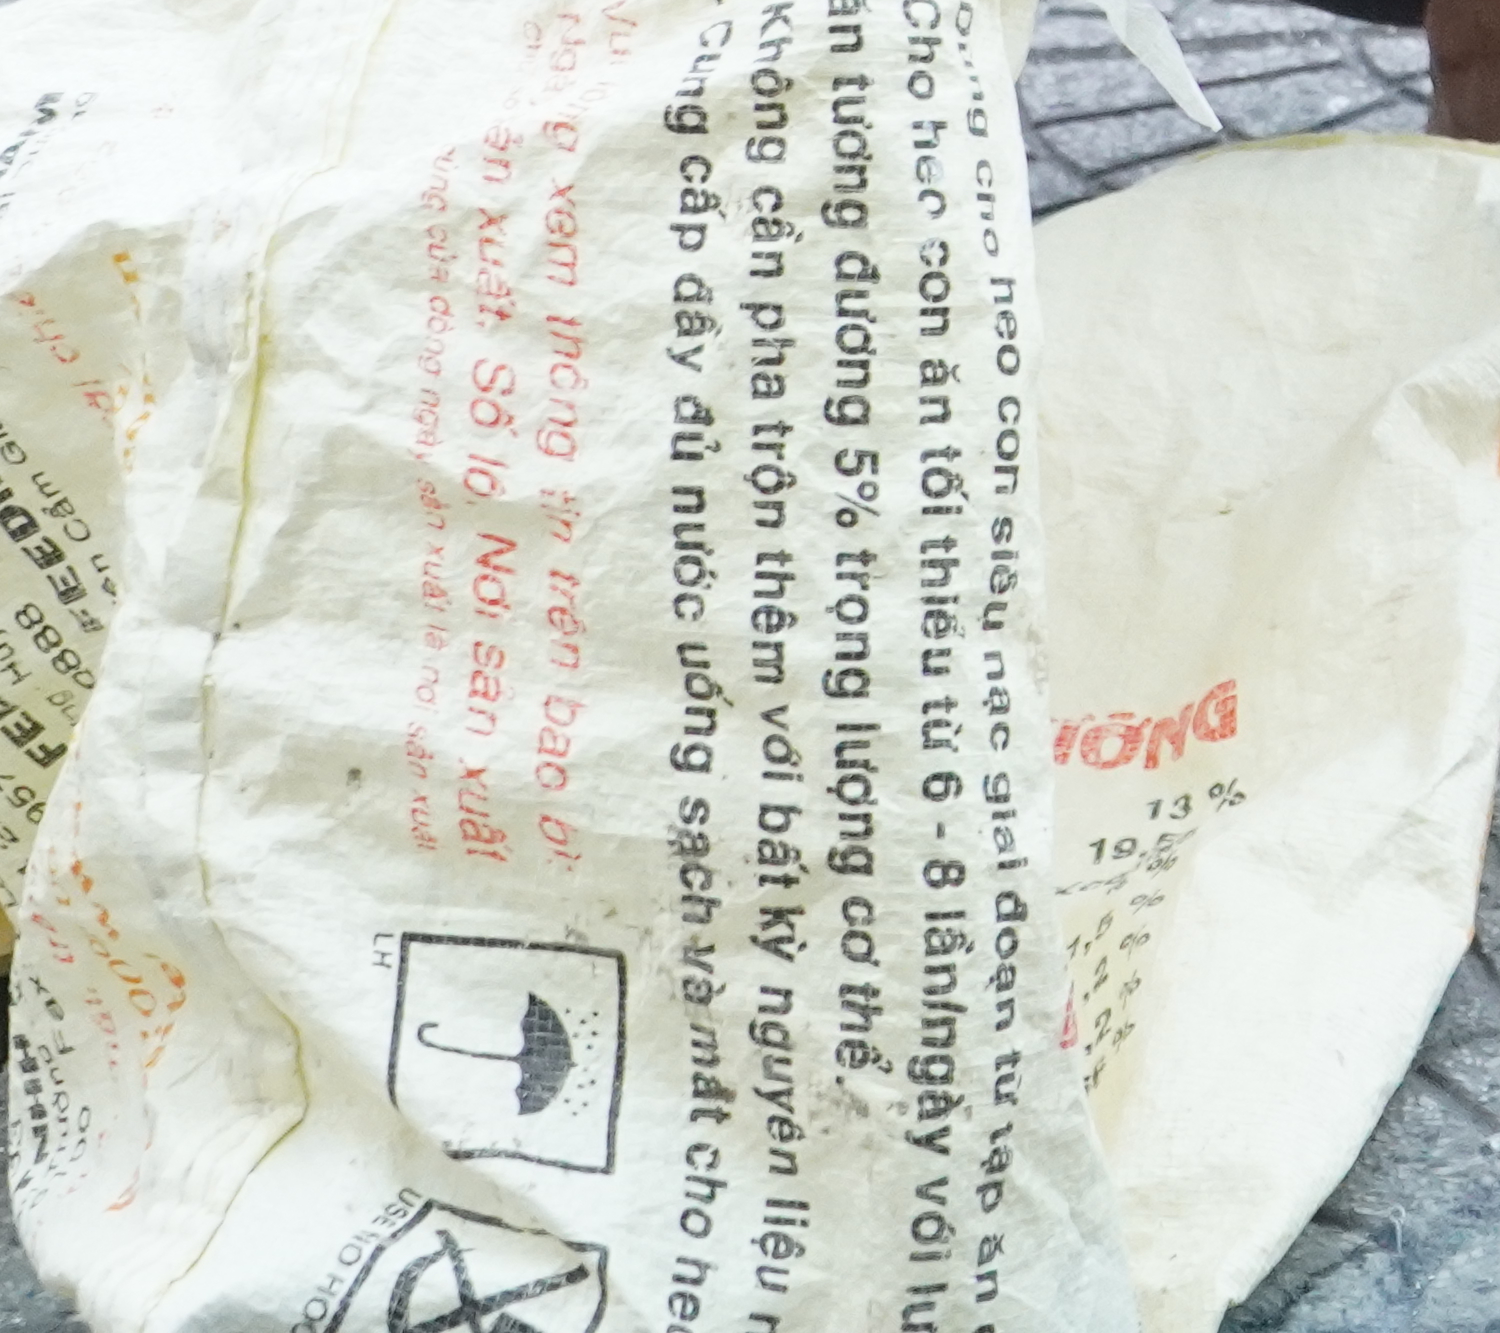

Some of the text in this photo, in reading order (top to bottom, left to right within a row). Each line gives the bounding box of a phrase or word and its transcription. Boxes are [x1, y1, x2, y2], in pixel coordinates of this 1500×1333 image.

[664, 19, 734, 136] Cung
[747, 2, 795, 162] Không
[821, 74, 878, 230] tương
[543, 182, 580, 287] xem
[675, 156, 727, 252] cấp
[750, 186, 802, 279] cần
[975, 160, 1001, 258] cho
[666, 274, 722, 372] đầy
[918, 239, 950, 337] con
[991, 275, 1022, 376] heo
[741, 302, 794, 401] pha
[824, 252, 880, 427] đương
[470, 358, 518, 439] Số
[670, 395, 722, 462] đủ
[919, 360, 961, 425] ăn
[742, 422, 794, 529] trộn
[831, 449, 880, 529] 5%
[919, 445, 970, 517] tối
[994, 395, 1023, 495] con
[538, 488, 580, 546] tin
[670, 486, 717, 622] nước
[472, 532, 518, 621] Nơi
[545, 569, 587, 670] trên
[751, 551, 797, 685] thêm
[822, 552, 878, 699] trọng
[534, 696, 587, 791] bao
[669, 642, 738, 774] uống
[759, 705, 803, 782] với
[920, 697, 968, 754] từ
[983, 651, 1014, 753] nạc
[458, 764, 512, 864] xuất
[826, 722, 881, 875] lượng
[921, 772, 964, 803] 6
[980, 772, 1028, 872] giai
[1148, 793, 1193, 820] 13
[668, 795, 725, 925] sạch
[758, 804, 808, 889] bất
[921, 859, 966, 889] 8
[372, 932, 393, 969] LH
[679, 944, 723, 1006] và
[750, 907, 808, 963] kỳ
[839, 897, 880, 965] cơ
[994, 891, 1028, 1032] đoạn
[749, 984, 799, 1177] nguyên
[834, 982, 894, 1087] thể.
[905, 911, 976, 1157] lần/ngày
[371, 1187, 423, 1230] USE
[678, 1142, 728, 1239] cho
[908, 1177, 953, 1263] với
[753, 1197, 809, 1294] liệu
[974, 1236, 1004, 1303] ăn
